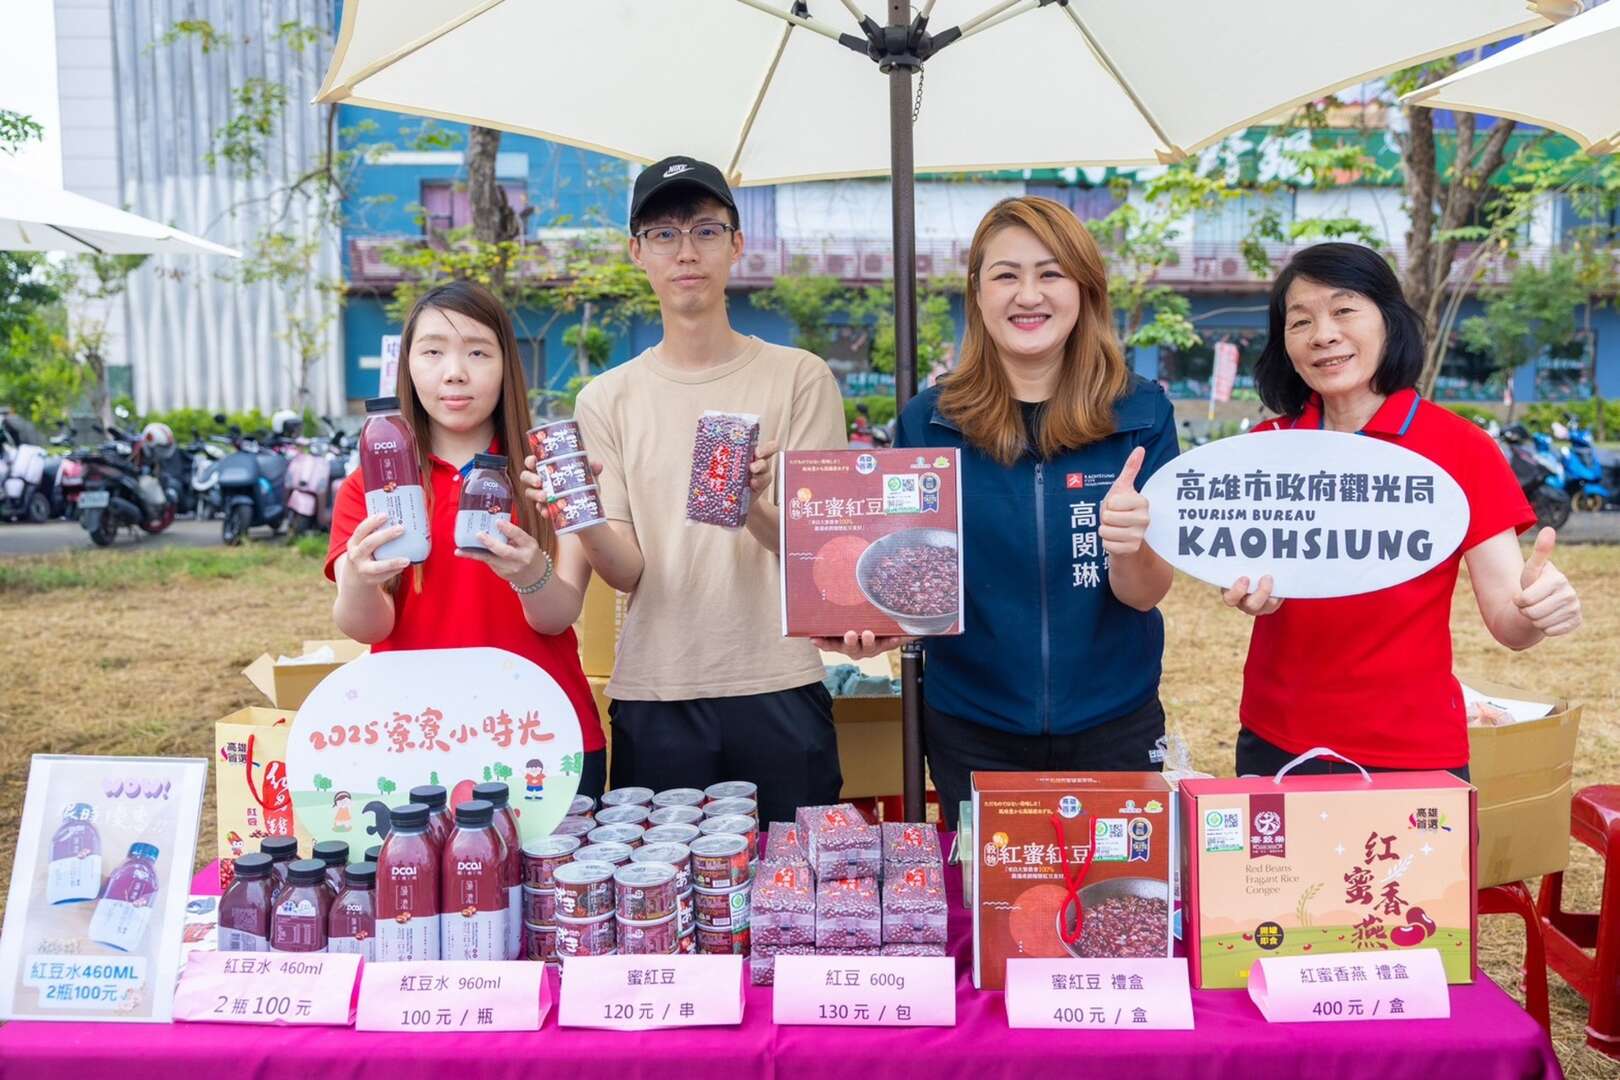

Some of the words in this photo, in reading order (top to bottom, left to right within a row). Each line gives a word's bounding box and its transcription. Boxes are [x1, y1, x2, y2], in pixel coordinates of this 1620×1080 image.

[668, 163, 688, 173] NIKE
[1176, 469, 1435, 504] 高雄市政府觀光局
[802, 496, 886, 519] 紅蜜紅豆
[1178, 508, 1247, 521] TOURISM
[1252, 509, 1316, 522] BUREAU
[1069, 500, 1101, 588] 高閔琳
[1178, 525, 1434, 561] KAOHSIUNG
[309, 706, 555, 753] 2025寮寮小時光
[227, 743, 247, 752] 高雄
[228, 753, 248, 763] 首選
[103, 776, 171, 800] WOW!
[1416, 807, 1438, 817] 高雄
[1416, 818, 1438, 830] 首選
[999, 842, 1093, 865] 紅蜜紅豆
[1245, 864, 1263, 873] Red
[1266, 864, 1292, 873] Beans
[1280, 874, 1300, 884] Rice
[1246, 885, 1281, 895] Congee
[30, 962, 139, 980] 紅豆水460ML
[224, 957, 271, 975] 紅豆水
[279, 959, 323, 976] 460ml
[1300, 964, 1368, 983] 紅蜜香燕
[1376, 963, 1410, 981] 禮盒
[400, 975, 449, 992] 紅豆水
[458, 976, 501, 990] 960ml
[627, 968, 676, 986] 蜜紅豆
[826, 968, 861, 987] 紅豆
[870, 972, 905, 990] 600g
[1051, 973, 1102, 991] 蜜紅豆
[1111, 973, 1145, 991] 禮盒
[46, 983, 118, 1001] 2瓶100元
[213, 995, 229, 1014] 2
[232, 998, 249, 1015] 瓶
[252, 996, 291, 1015] 100
[296, 1000, 313, 1017] 元
[603, 1003, 634, 1020] 120
[638, 1003, 655, 1021] 元
[679, 1002, 695, 1019] 串
[818, 1004, 849, 1020] 130
[853, 1003, 870, 1020] 元
[896, 1003, 912, 1021] 包
[1053, 1007, 1084, 1024] 400
[1089, 1006, 1106, 1024] 元
[1131, 1006, 1148, 1024] 盒
[1313, 1000, 1342, 1017] 400
[1347, 998, 1364, 1016] 元
[1389, 997, 1405, 1015] 盒
[400, 1009, 431, 1026] 100
[435, 1009, 452, 1026] 元
[477, 1007, 494, 1025] 瓶
